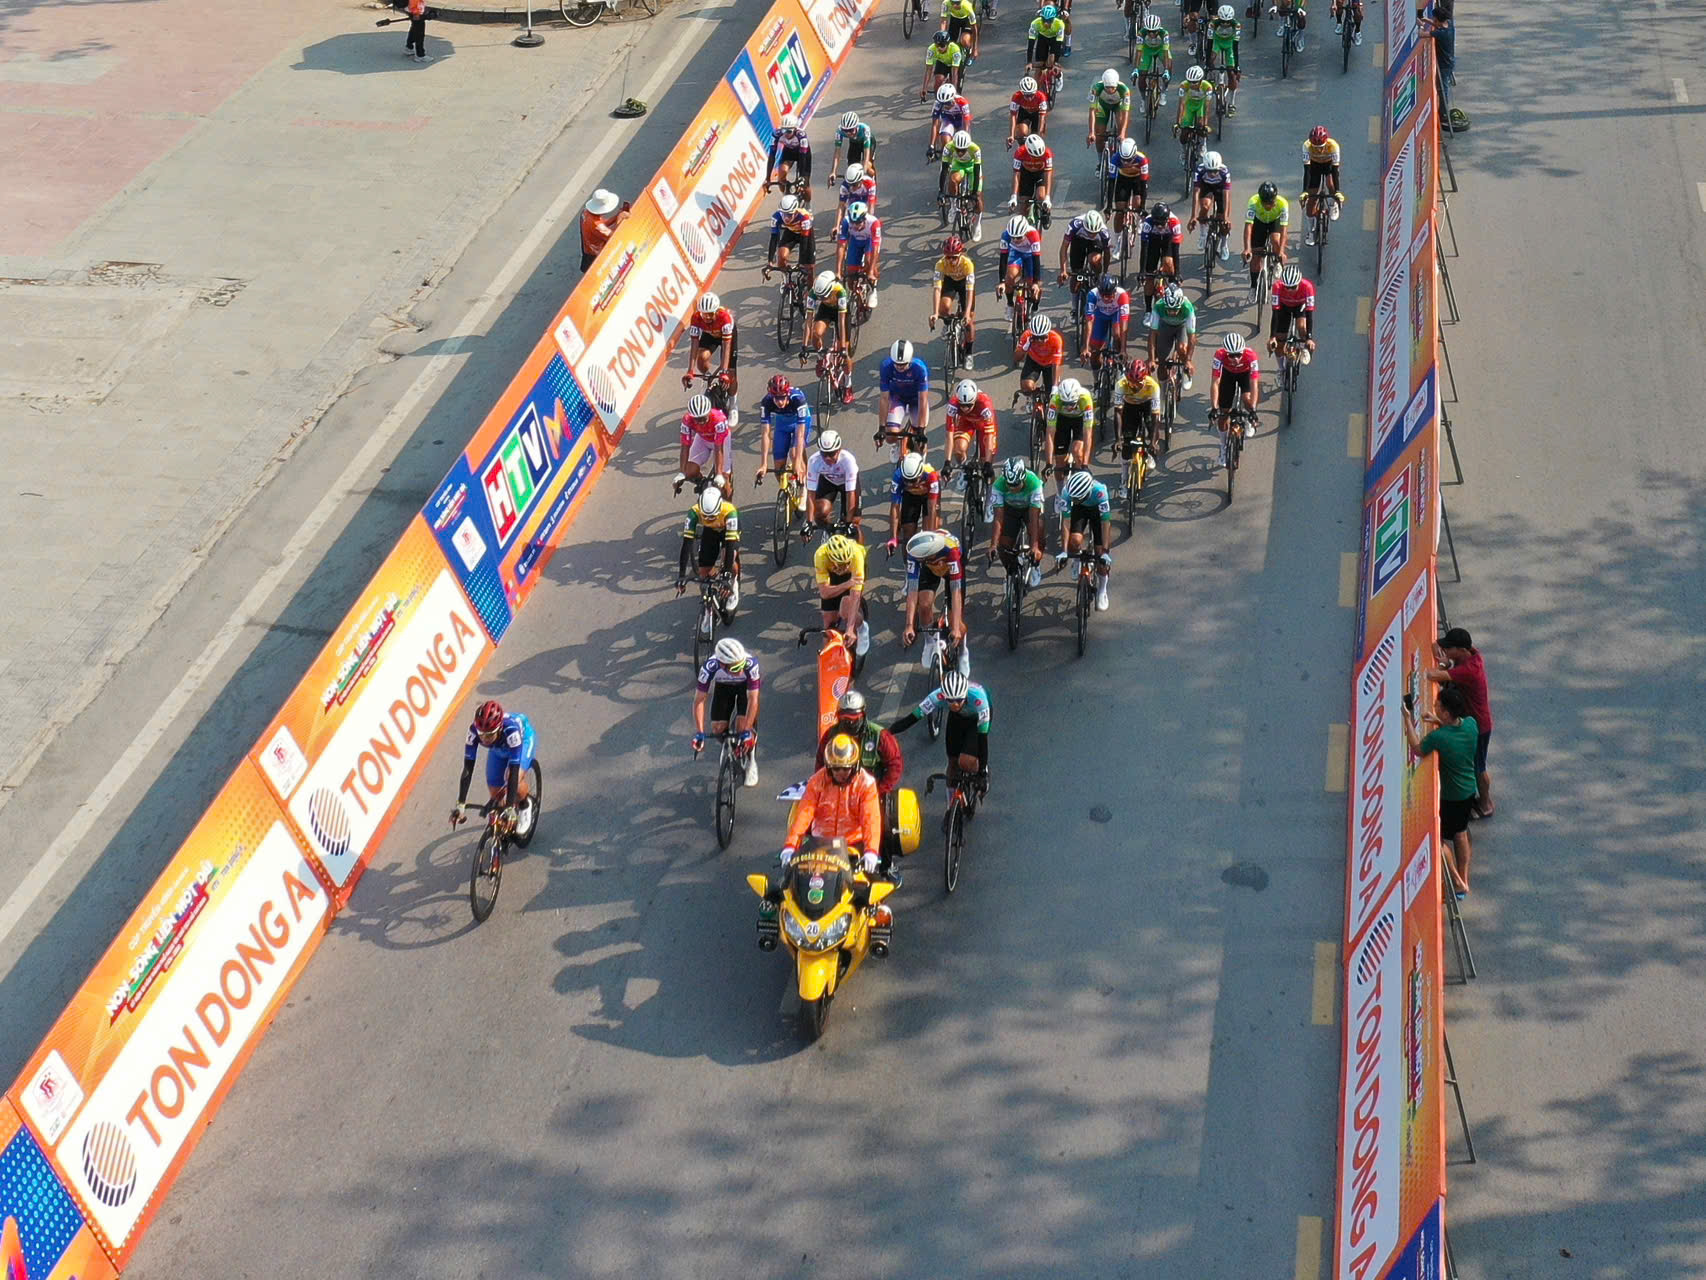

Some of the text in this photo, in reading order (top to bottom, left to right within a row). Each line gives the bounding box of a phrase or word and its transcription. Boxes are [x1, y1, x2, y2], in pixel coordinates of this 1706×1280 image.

[769, 34, 812, 111] HTV
[828, 0, 851, 37] TON
[1392, 60, 1415, 132] HTV
[701, 194, 731, 245] TON
[721, 155, 757, 206] DONG
[748, 140, 765, 163] A
[607, 327, 646, 391] TON
[637, 277, 678, 350] DONG
[669, 263, 690, 289] A
[1376, 340, 1397, 421] DONG
[1379, 300, 1397, 353] TON
[484, 411, 550, 532] HTV
[1374, 468, 1408, 588] HTV
[341, 722, 402, 815] TON
[388, 633, 457, 745] DONG
[449, 610, 477, 654] A
[1358, 679, 1385, 921] TON DONG A
[106, 979, 130, 1016] NON
[130, 943, 161, 981] SÔNG
[126, 1025, 211, 1146] TON
[196, 900, 289, 1048] DONG
[283, 871, 317, 923] A
[1349, 971, 1383, 1280] TON DONG A
